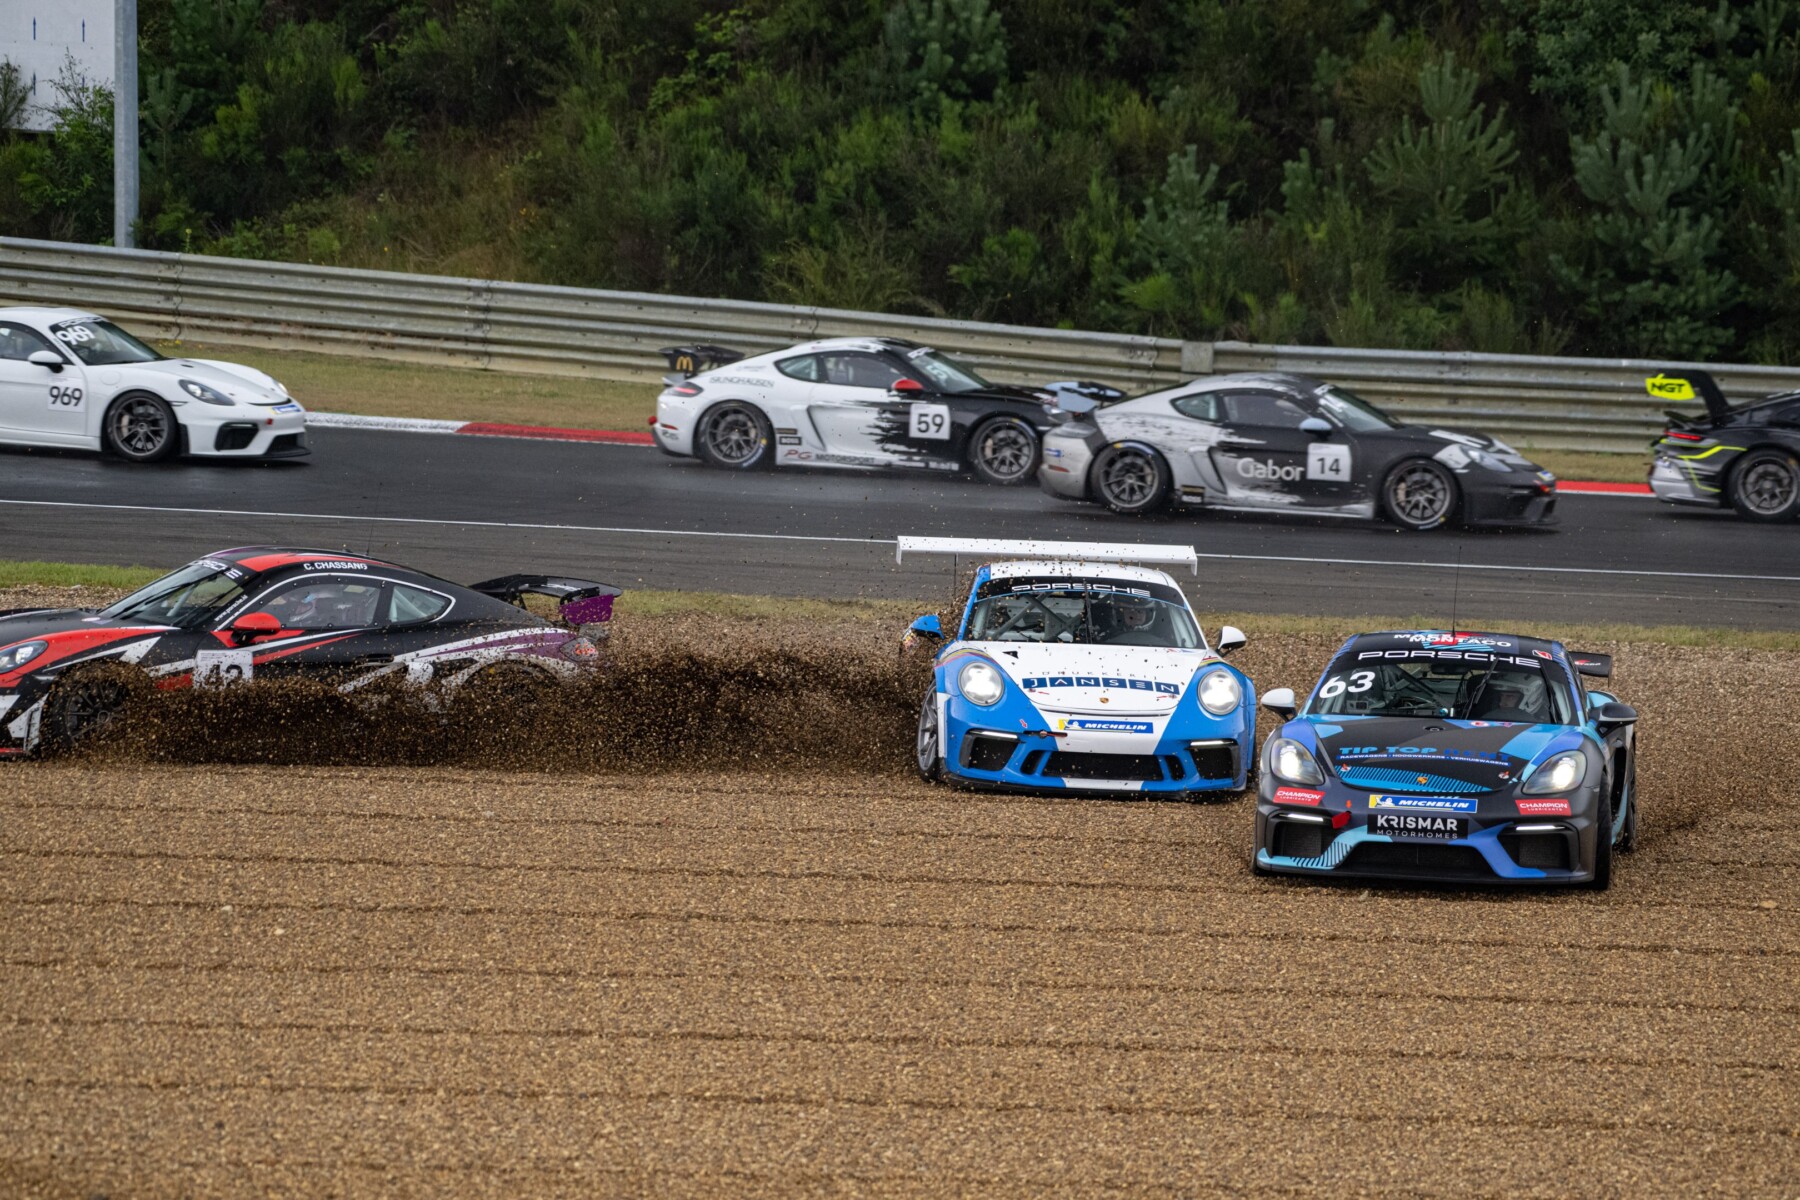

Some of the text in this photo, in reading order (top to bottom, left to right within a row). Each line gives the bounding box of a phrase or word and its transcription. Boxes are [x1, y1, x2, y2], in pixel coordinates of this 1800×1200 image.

[56, 326, 95, 345] 969
[1650, 382, 1686, 394] NGT
[50, 386, 83, 407] 969
[917, 413, 945, 433] 59
[815, 453, 875, 464] MOTORSPORT
[1317, 457, 1341, 476] 14
[1237, 457, 1305, 481] Gabor
[1011, 583, 1151, 598] PORSCHE
[1409, 635, 1511, 647] MONTACO
[1358, 650, 1541, 668] PORSCHE
[1029, 677, 1176, 693] JANSEN
[1319, 671, 1376, 699] 63
[1339, 746, 1378, 755] TIP
[1386, 746, 1438, 754] TOP
[1277, 790, 1321, 800] CHAMPION
[1398, 799, 1470, 809] MICHELIN
[1377, 814, 1459, 832] KRISMAR
[1376, 829, 1459, 840] MOTORHOMES
